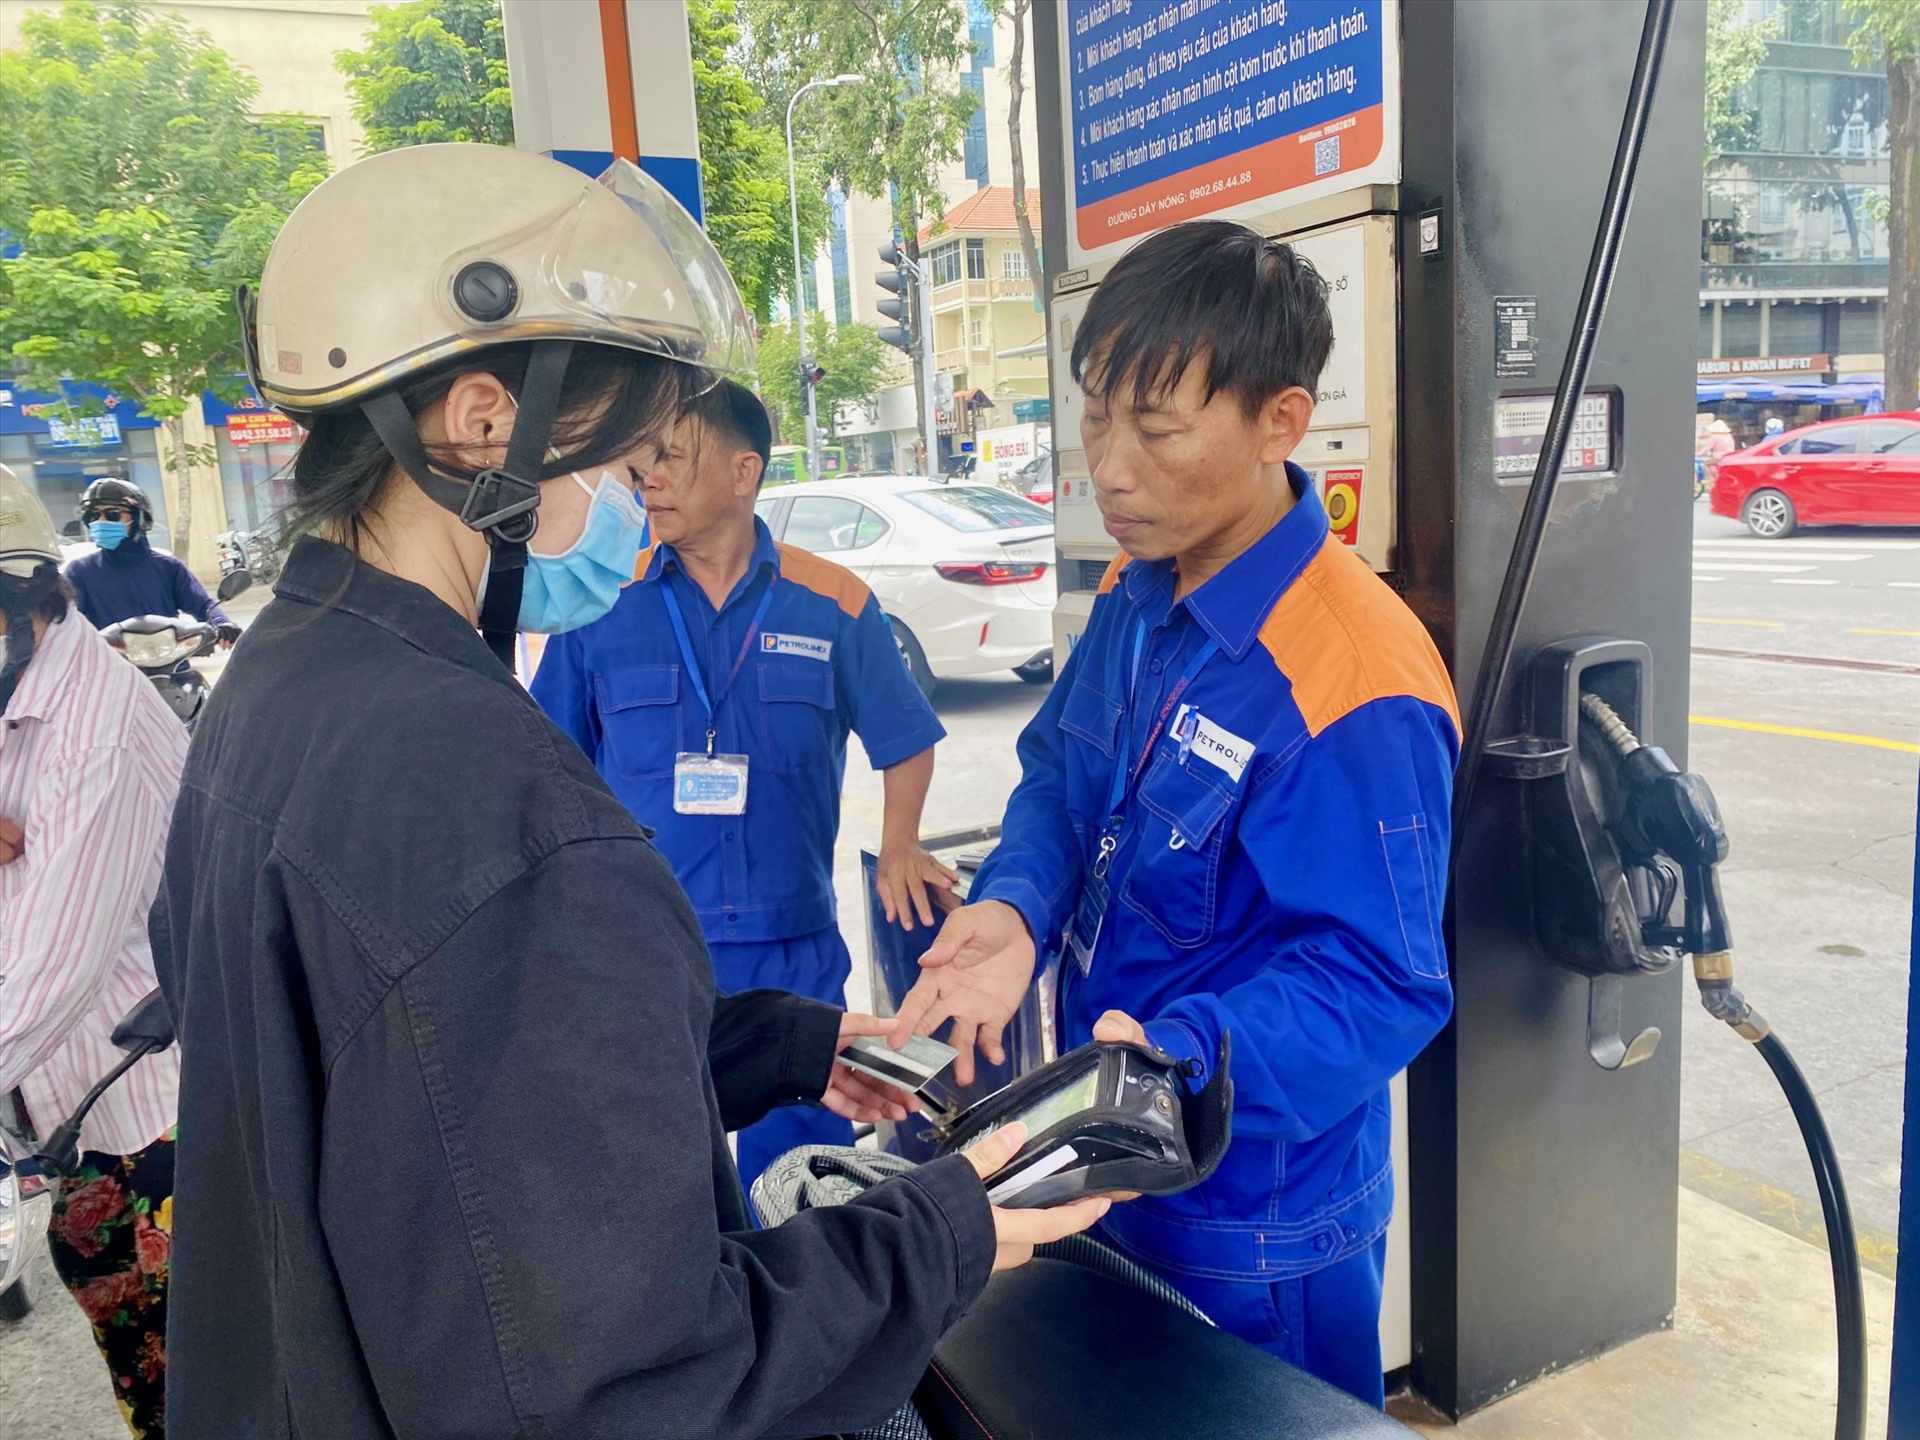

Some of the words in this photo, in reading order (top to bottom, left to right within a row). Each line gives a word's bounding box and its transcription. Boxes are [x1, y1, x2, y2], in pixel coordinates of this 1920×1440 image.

[1076, 9, 1089, 36] của
[1089, 0, 1111, 29] khách
[1077, 51, 1085, 74] 2.
[1086, 42, 1099, 69] Mời
[1099, 32, 1122, 63] khách
[1122, 25, 1142, 50] hàng
[1142, 14, 1157, 41] xác
[1158, 3, 1179, 33] nhận
[1078, 89, 1086, 111] 3.
[1088, 84, 1104, 107] Bơm
[1105, 74, 1124, 99] hàng
[1124, 64, 1146, 90] đúng,
[1147, 52, 1158, 80] đủ
[1158, 50, 1176, 75] theo
[1177, 39, 1193, 73] yêu
[1212, 19, 1229, 50] của
[1230, 7, 1259, 42] khách
[1260, 0, 1288, 28] hàng.
[1080, 126, 1088, 148] 4.
[1089, 117, 1103, 145] Mời
[1103, 109, 1125, 139] khách
[1125, 104, 1145, 130] hàng
[1145, 95, 1160, 121] xác
[1161, 86, 1181, 117] nhận
[1183, 78, 1201, 106] màn
[1202, 67, 1222, 98] hình
[1223, 60, 1239, 92] cột
[1240, 56, 1261, 83] bơm
[1262, 39, 1287, 74] trước
[1289, 30, 1305, 62] khi
[1307, 17, 1338, 55] thanh
[1340, 6, 1368, 41] toán.
[1081, 164, 1089, 186] 5.
[1091, 156, 1109, 184] Thực
[1109, 148, 1126, 178] hiện
[1126, 140, 1148, 169] thanh
[1149, 132, 1166, 161] toán
[1167, 127, 1178, 153] và
[1178, 121, 1194, 150] xác
[1195, 113, 1217, 145] nhận
[1218, 103, 1233, 135] kết
[1234, 96, 1254, 134] quả,
[1255, 90, 1276, 121] cảm
[1277, 88, 1291, 112] ơn
[1292, 71, 1324, 108] khách
[1326, 63, 1357, 95] hàng.
[1107, 208, 1137, 227] ĐƯỜNG
[1138, 201, 1157, 217] DÂY
[1189, 170, 1252, 201] 0902.68.44.88
[1060, 271, 1088, 287] TATSUNO
[1335, 275, 1348, 291] SỐ
[1777, 357, 1812, 371] BUFFET
[1585, 452, 1592, 463] C
[1327, 472, 1361, 481] EMERGENCY
[779, 640, 828, 654] PETROLIMEX
